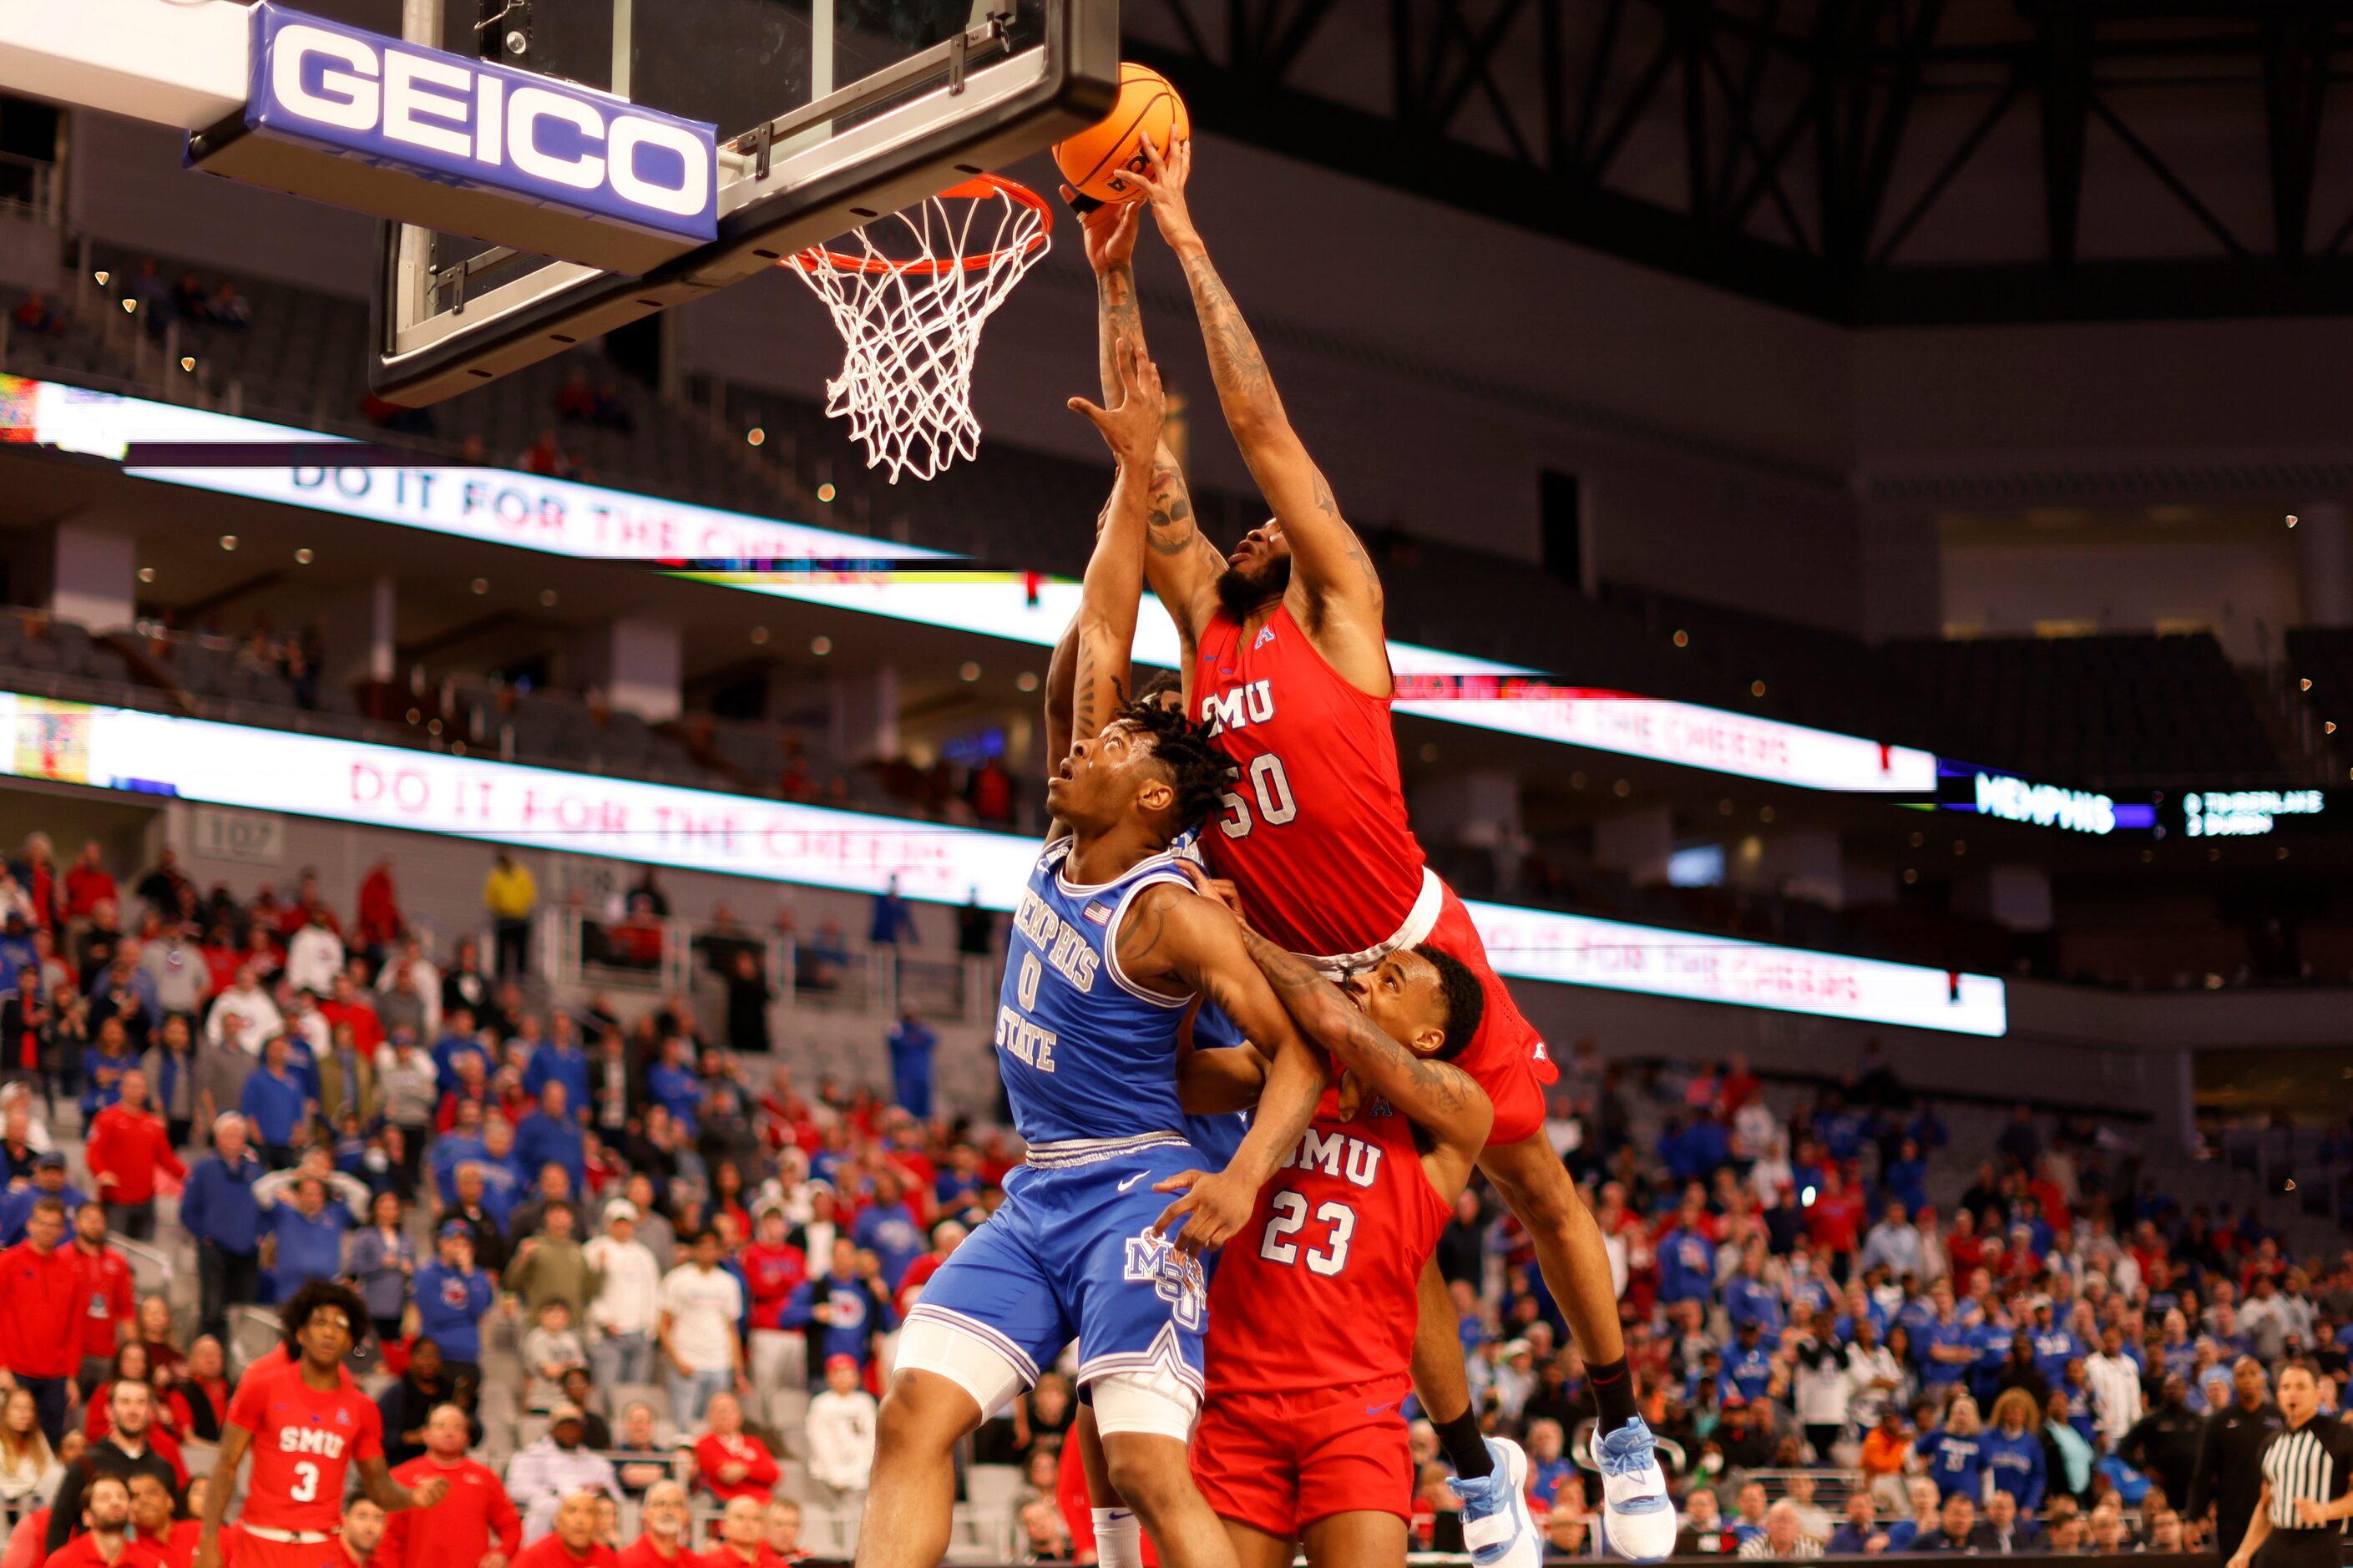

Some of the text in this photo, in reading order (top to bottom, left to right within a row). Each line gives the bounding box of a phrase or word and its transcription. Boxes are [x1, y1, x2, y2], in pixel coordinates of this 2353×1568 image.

[272, 24, 708, 215] GEICO
[397, 469, 437, 509] IT
[464, 480, 568, 529] FOR
[351, 761, 431, 815] DO
[1219, 753, 1298, 838] 50
[1976, 771, 2115, 834] MEMPHIS
[1017, 950, 1042, 1014] 0
[996, 1004, 1057, 1073] STATE
[1281, 1127, 1383, 1188] MU
[1260, 1190, 1356, 1277] 23
[279, 1425, 345, 1459] SMU
[290, 1461, 320, 1502] 3
